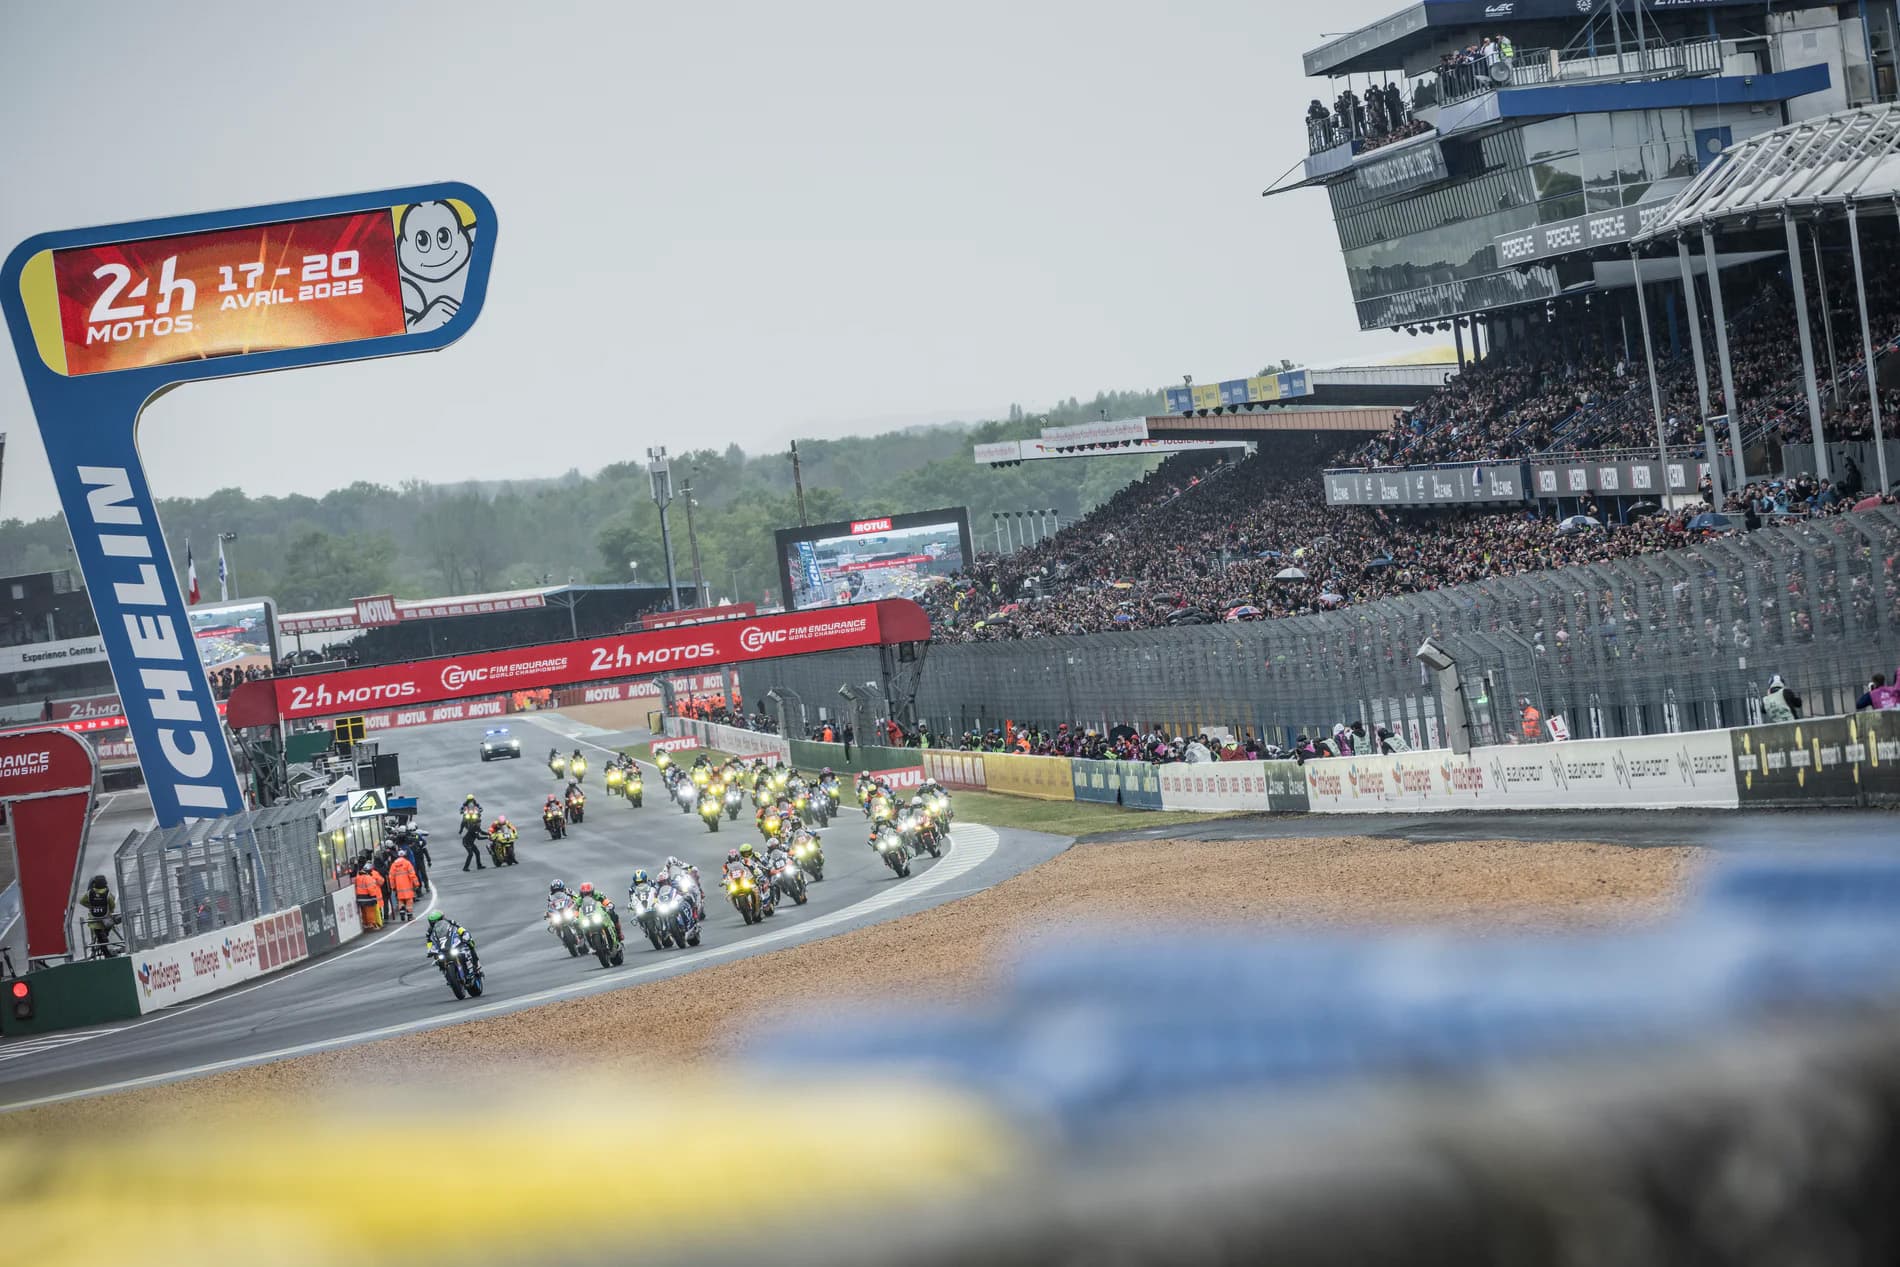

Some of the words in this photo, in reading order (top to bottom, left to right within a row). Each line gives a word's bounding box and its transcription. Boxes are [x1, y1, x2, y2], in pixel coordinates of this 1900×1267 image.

[1501, 235, 1535, 259] PORSCHE
[1545, 225, 1581, 248] PORSCHE
[1589, 215, 1626, 240] PORSCHE
[218, 262, 265, 293] 17
[275, 268, 291, 276] -
[301, 250, 360, 282] 20
[220, 289, 293, 311] AVRIL
[298, 279, 364, 301] 2025
[86, 315, 194, 344] MOTOS
[854, 522, 890, 533] MOTUL
[357, 599, 396, 624] MOTUL
[788, 633, 813, 641] WORLD
[814, 626, 866, 638] CHAMPIONSHIP
[789, 627, 807, 635] FIM
[808, 619, 866, 633] ENDURANCE
[77, 466, 228, 824] ICHELIN
[744, 628, 787, 649] EWC
[22, 651, 67, 663] Experience
[69, 646, 96, 657] Center
[636, 643, 714, 665] MOTOS
[489, 670, 514, 679] WORLD
[515, 664, 567, 676] CHAMPIONSHIP
[490, 665, 508, 674] FIM
[509, 657, 568, 671] ENDURANCE
[445, 666, 488, 687] EWC
[336, 682, 415, 704] MOTOS
[585, 687, 621, 703] MOTUL
[628, 682, 661, 697] MOTU
[703, 674, 724, 689] MOTU
[98, 704, 120, 715] MO
[397, 710, 427, 725] MOTUL
[433, 706, 463, 720] MOTUL
[469, 702, 501, 716] MOTUL
[652, 738, 698, 753] MOTUL
[0, 752, 50, 768] ANCE
[438, 937, 448, 949] 7
